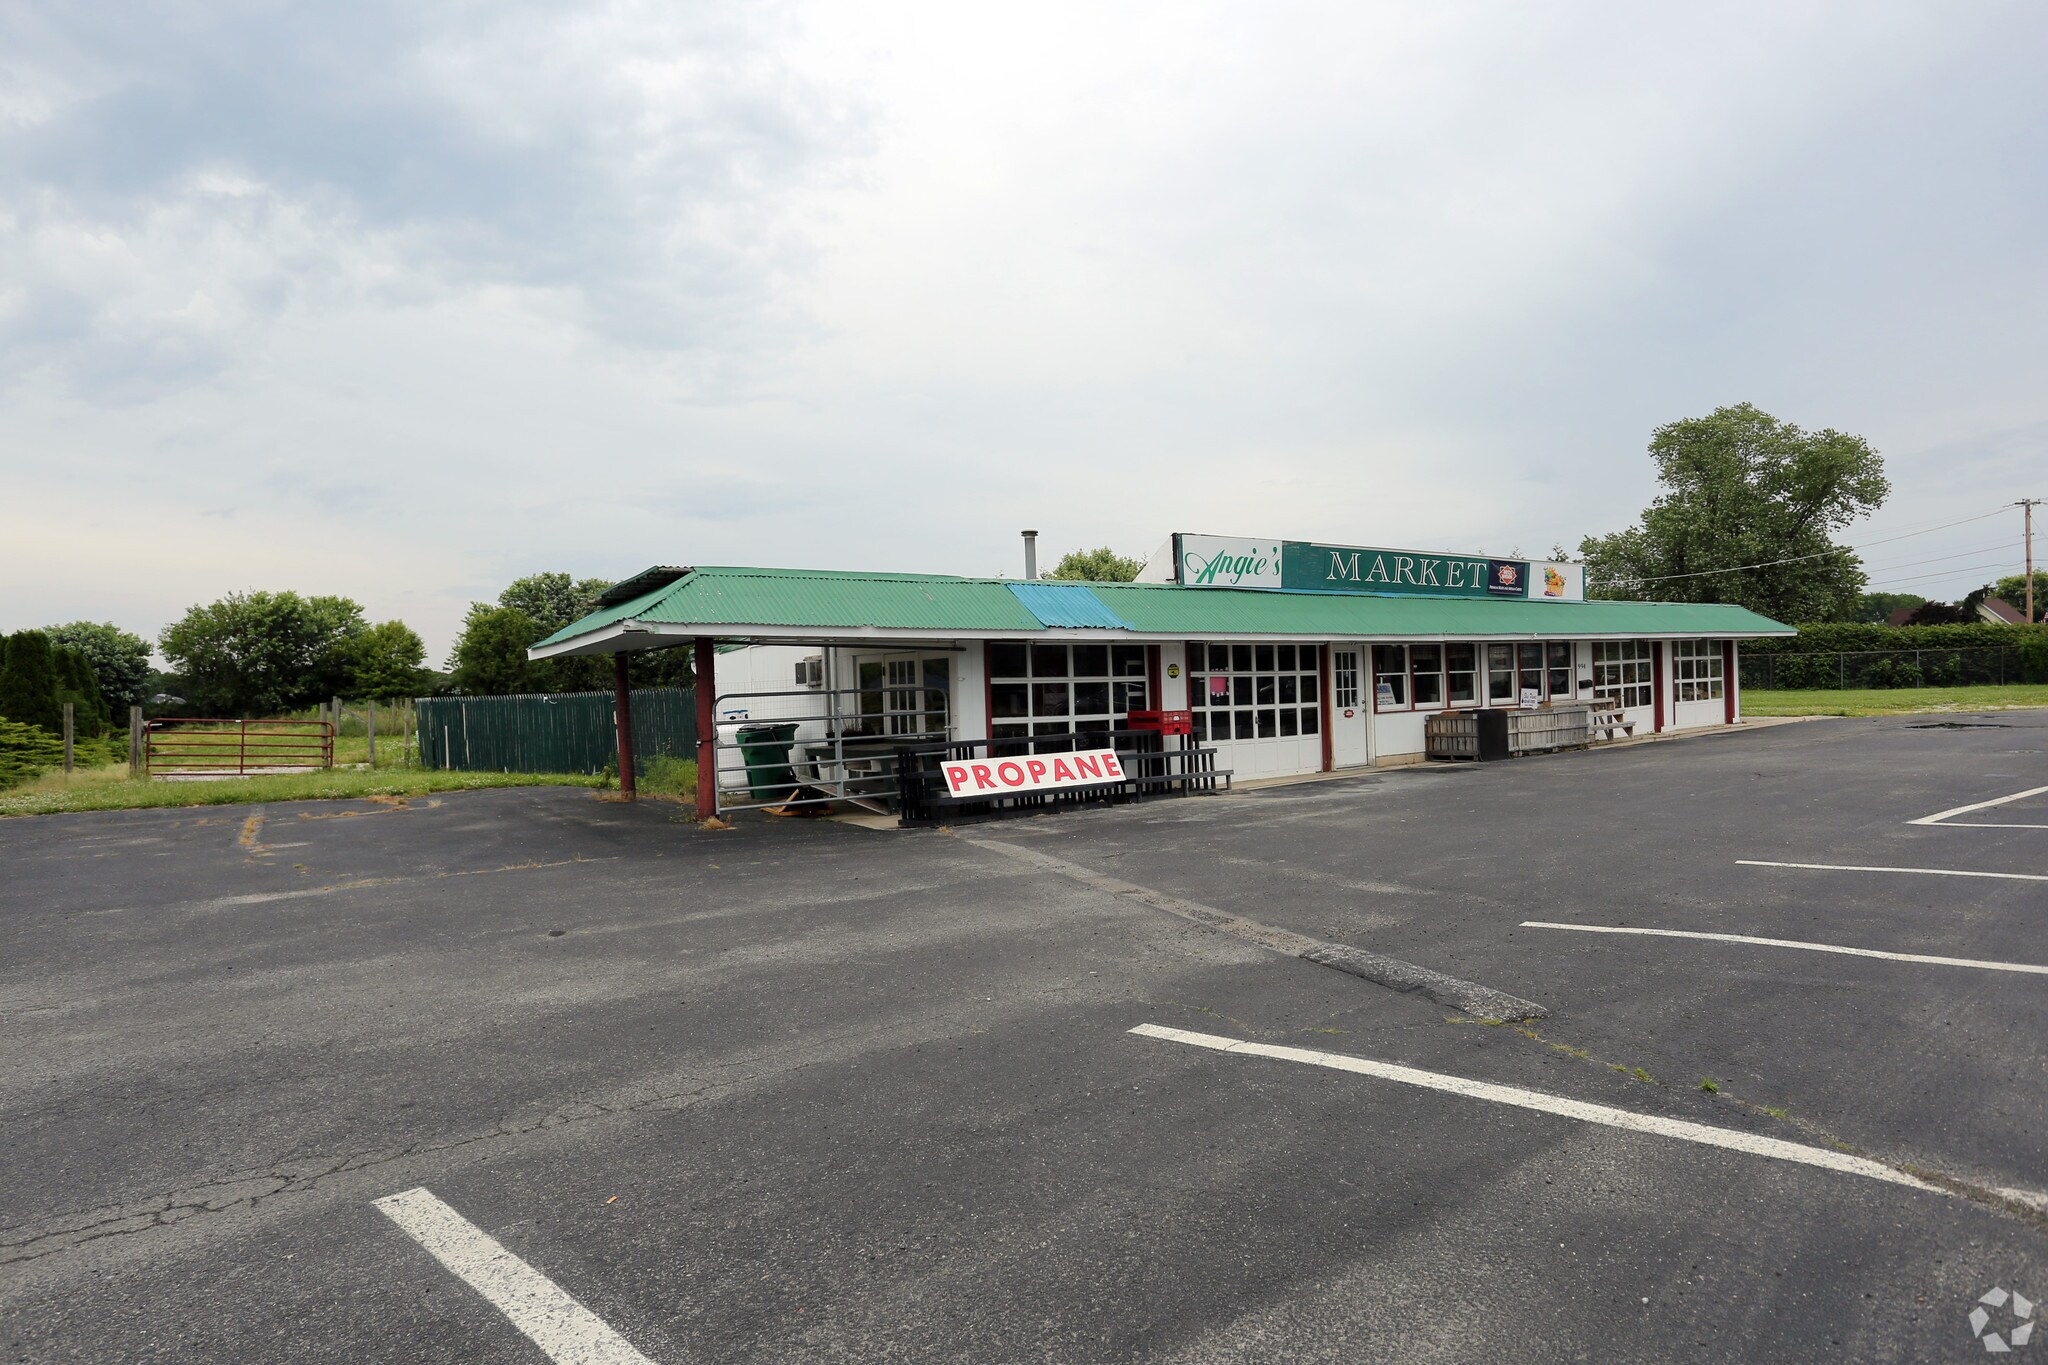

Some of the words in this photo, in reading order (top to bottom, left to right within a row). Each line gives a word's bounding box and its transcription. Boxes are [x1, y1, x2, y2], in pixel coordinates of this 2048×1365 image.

[1184, 546, 1281, 585] Angie's
[1326, 551, 1488, 588] MARKET
[946, 753, 1121, 792] PROPANE
